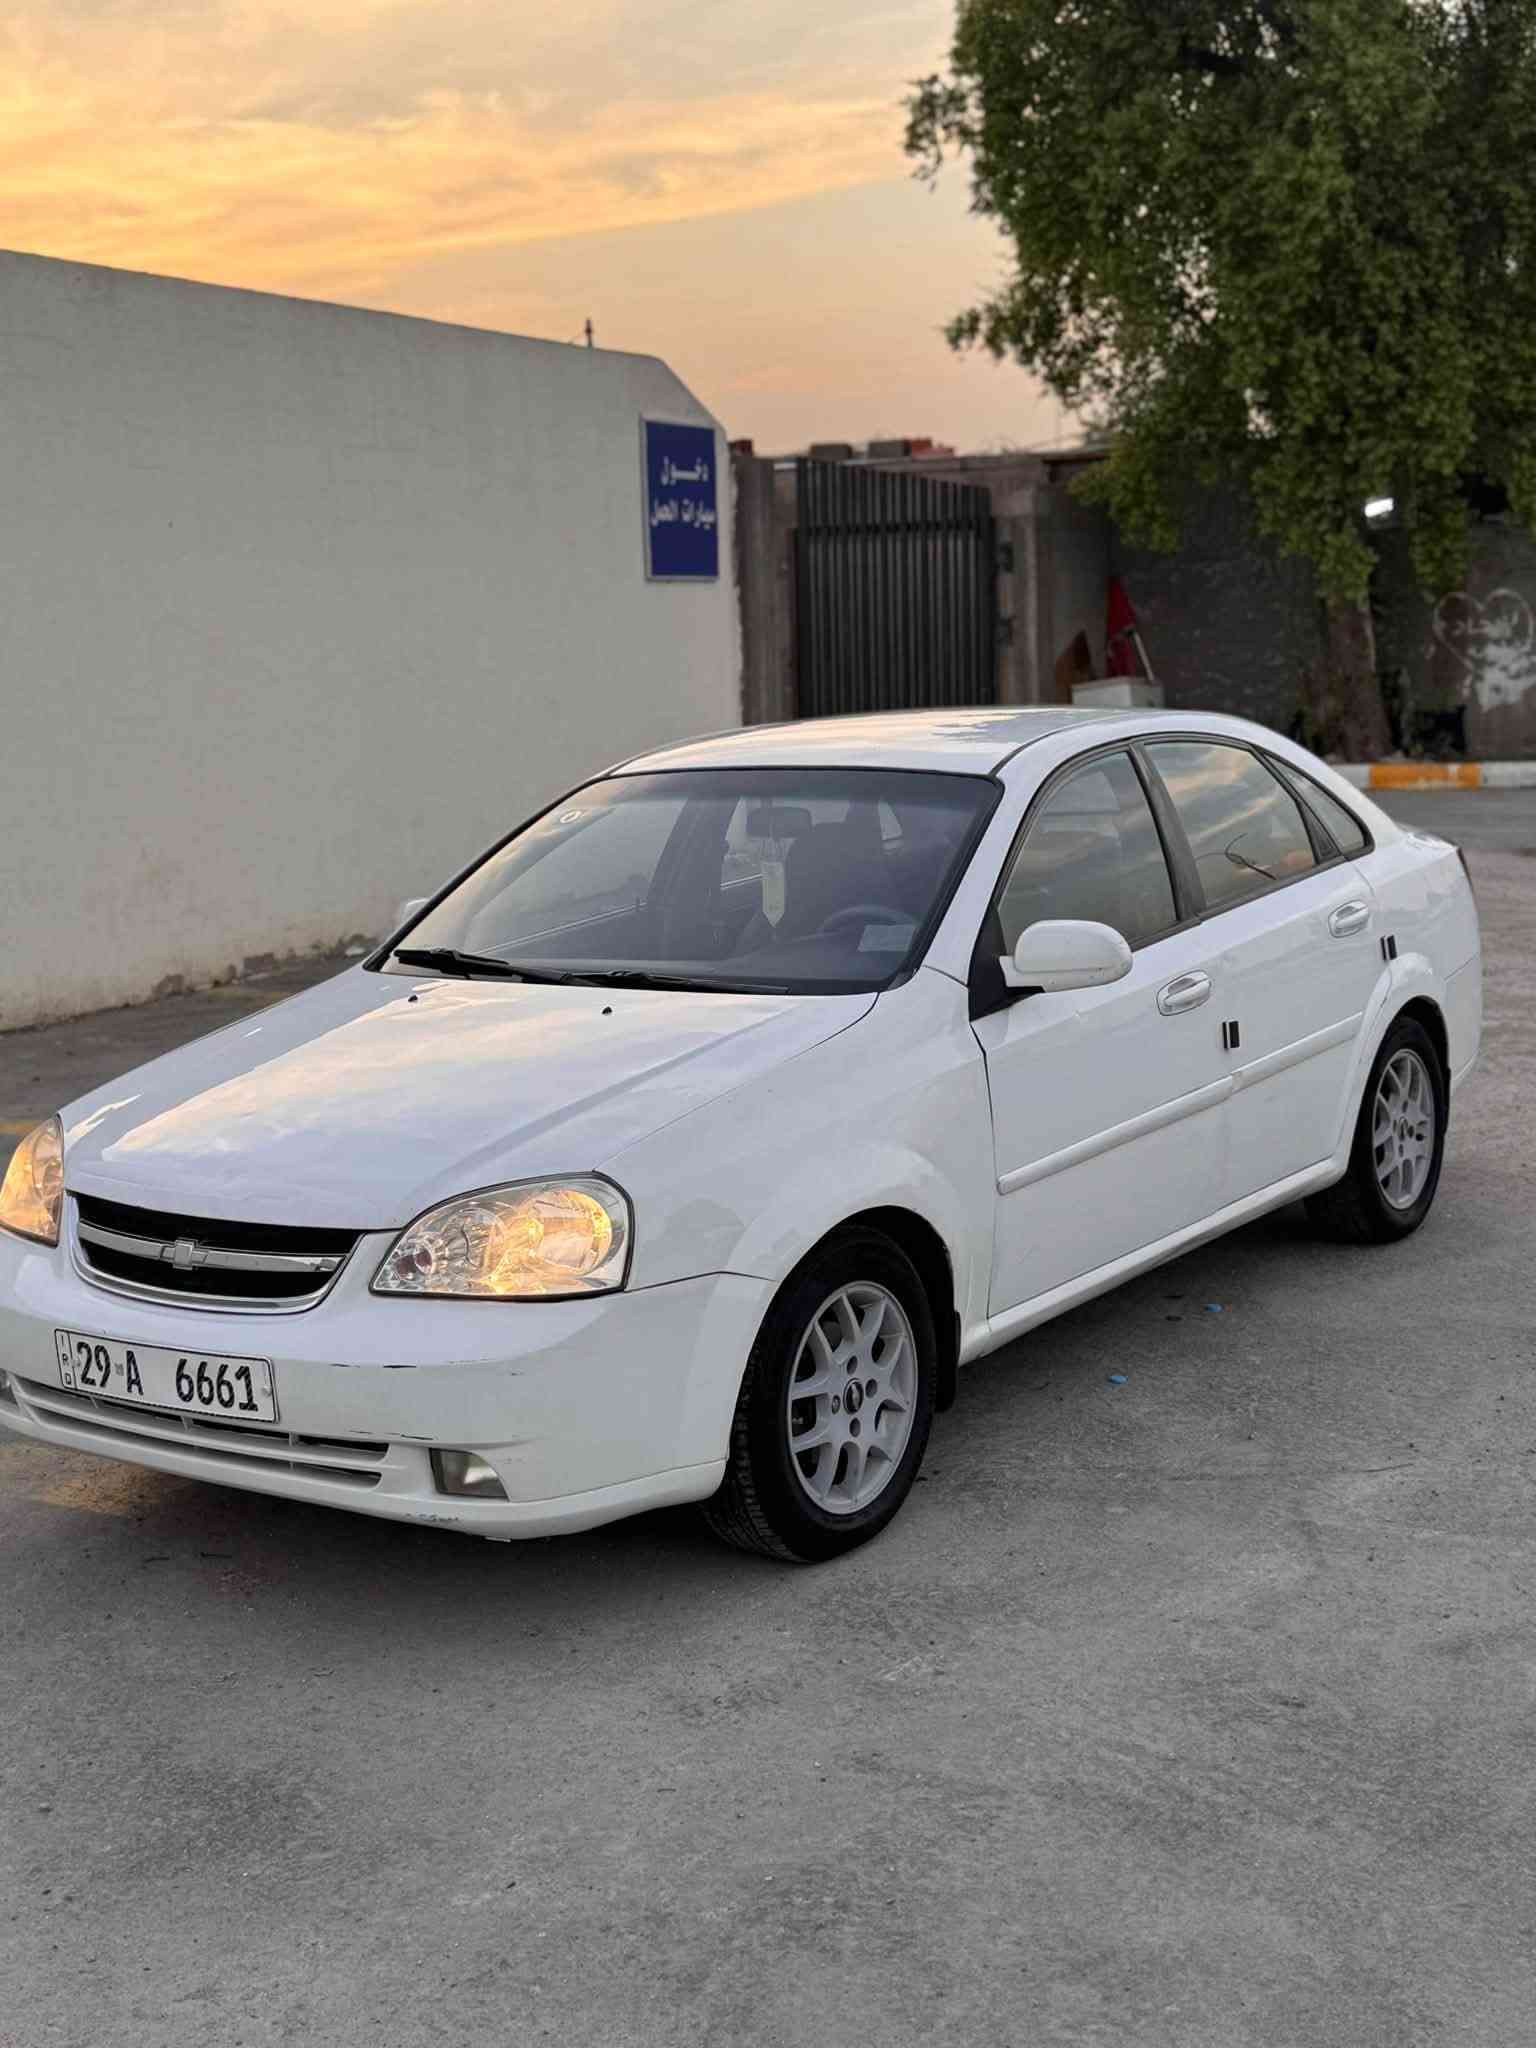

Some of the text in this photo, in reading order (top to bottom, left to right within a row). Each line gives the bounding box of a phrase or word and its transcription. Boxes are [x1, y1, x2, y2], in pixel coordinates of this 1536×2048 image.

[77, 1341, 259, 1412] 29 A 6661
